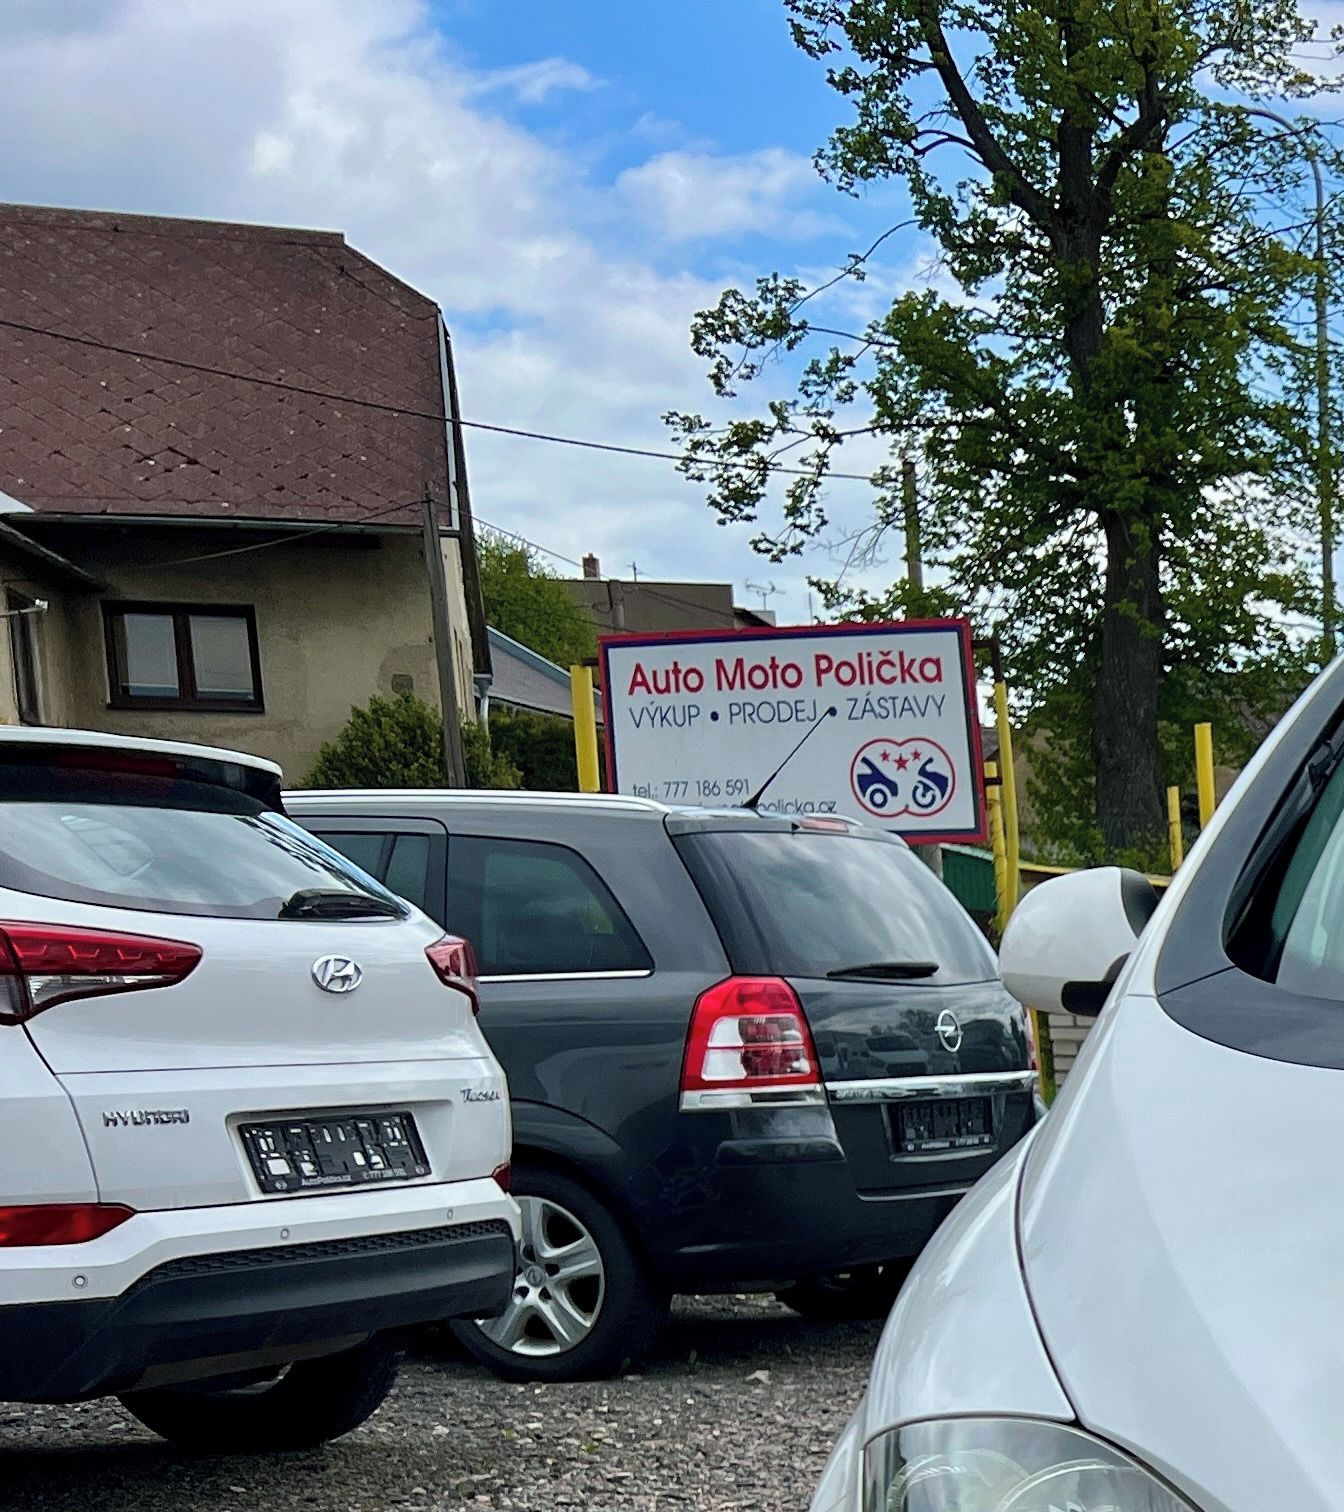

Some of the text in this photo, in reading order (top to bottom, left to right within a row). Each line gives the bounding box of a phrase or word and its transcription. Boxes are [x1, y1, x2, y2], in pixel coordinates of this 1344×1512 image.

[628, 650, 943, 696] Auto Moto Polička
[629, 691, 946, 728] VÝKUP PRODEJ ZÁSTAVY
[663, 781, 689, 798] 777
[695, 779, 721, 797] 186
[725, 778, 750, 796] 591
